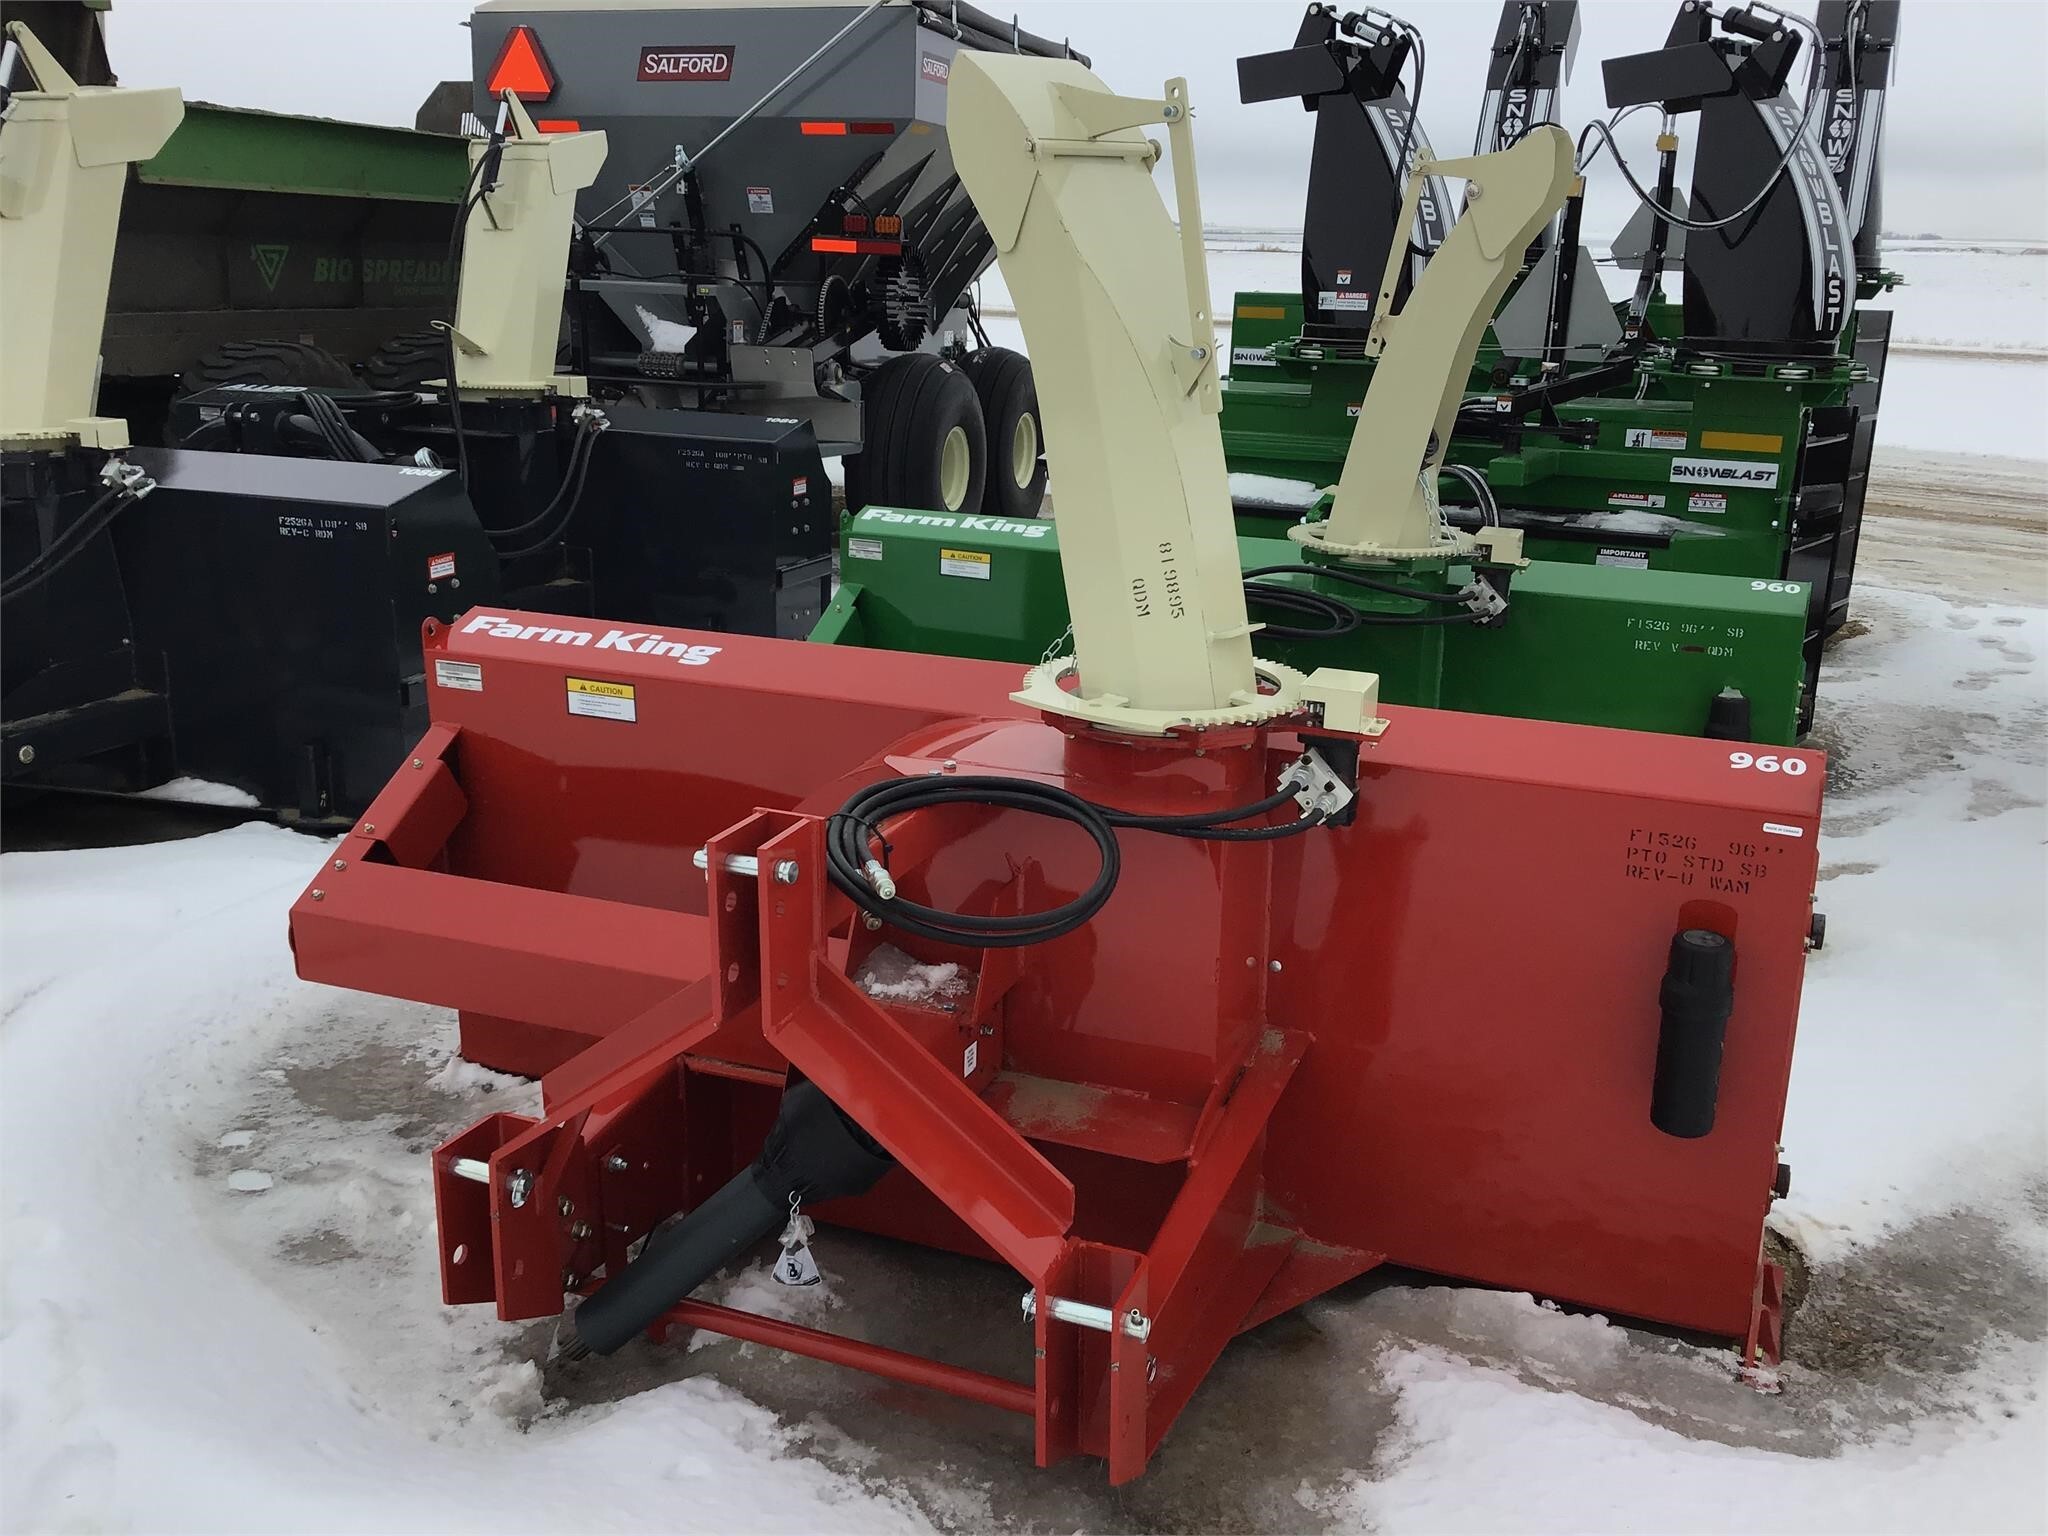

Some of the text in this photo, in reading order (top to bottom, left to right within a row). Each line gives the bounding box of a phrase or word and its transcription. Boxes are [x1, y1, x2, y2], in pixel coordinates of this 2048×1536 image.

[644, 53, 728, 73] SALFORD
[922, 57, 949, 80] SALFORD
[1774, 106, 1842, 331] SNOWBLAST
[313, 257, 354, 283] BIO
[1234, 353, 1270, 361] SNOW
[399, 467, 443, 477] 1080
[1672, 465, 1777, 482] SNOWBLAST
[861, 508, 1052, 538] Farm King
[957, 552, 983, 562] CAUTION
[1600, 548, 1647, 559] IMPORTANT
[1159, 542, 1185, 619] 819895
[1751, 580, 1801, 594] 960
[460, 615, 723, 666] Farm King
[1726, 627, 1744, 638] SB
[1635, 640, 1661, 651] REV
[589, 684, 623, 696] CAUTION
[1729, 752, 1808, 776] 960
[1627, 847, 1768, 879] PTO STD SB
